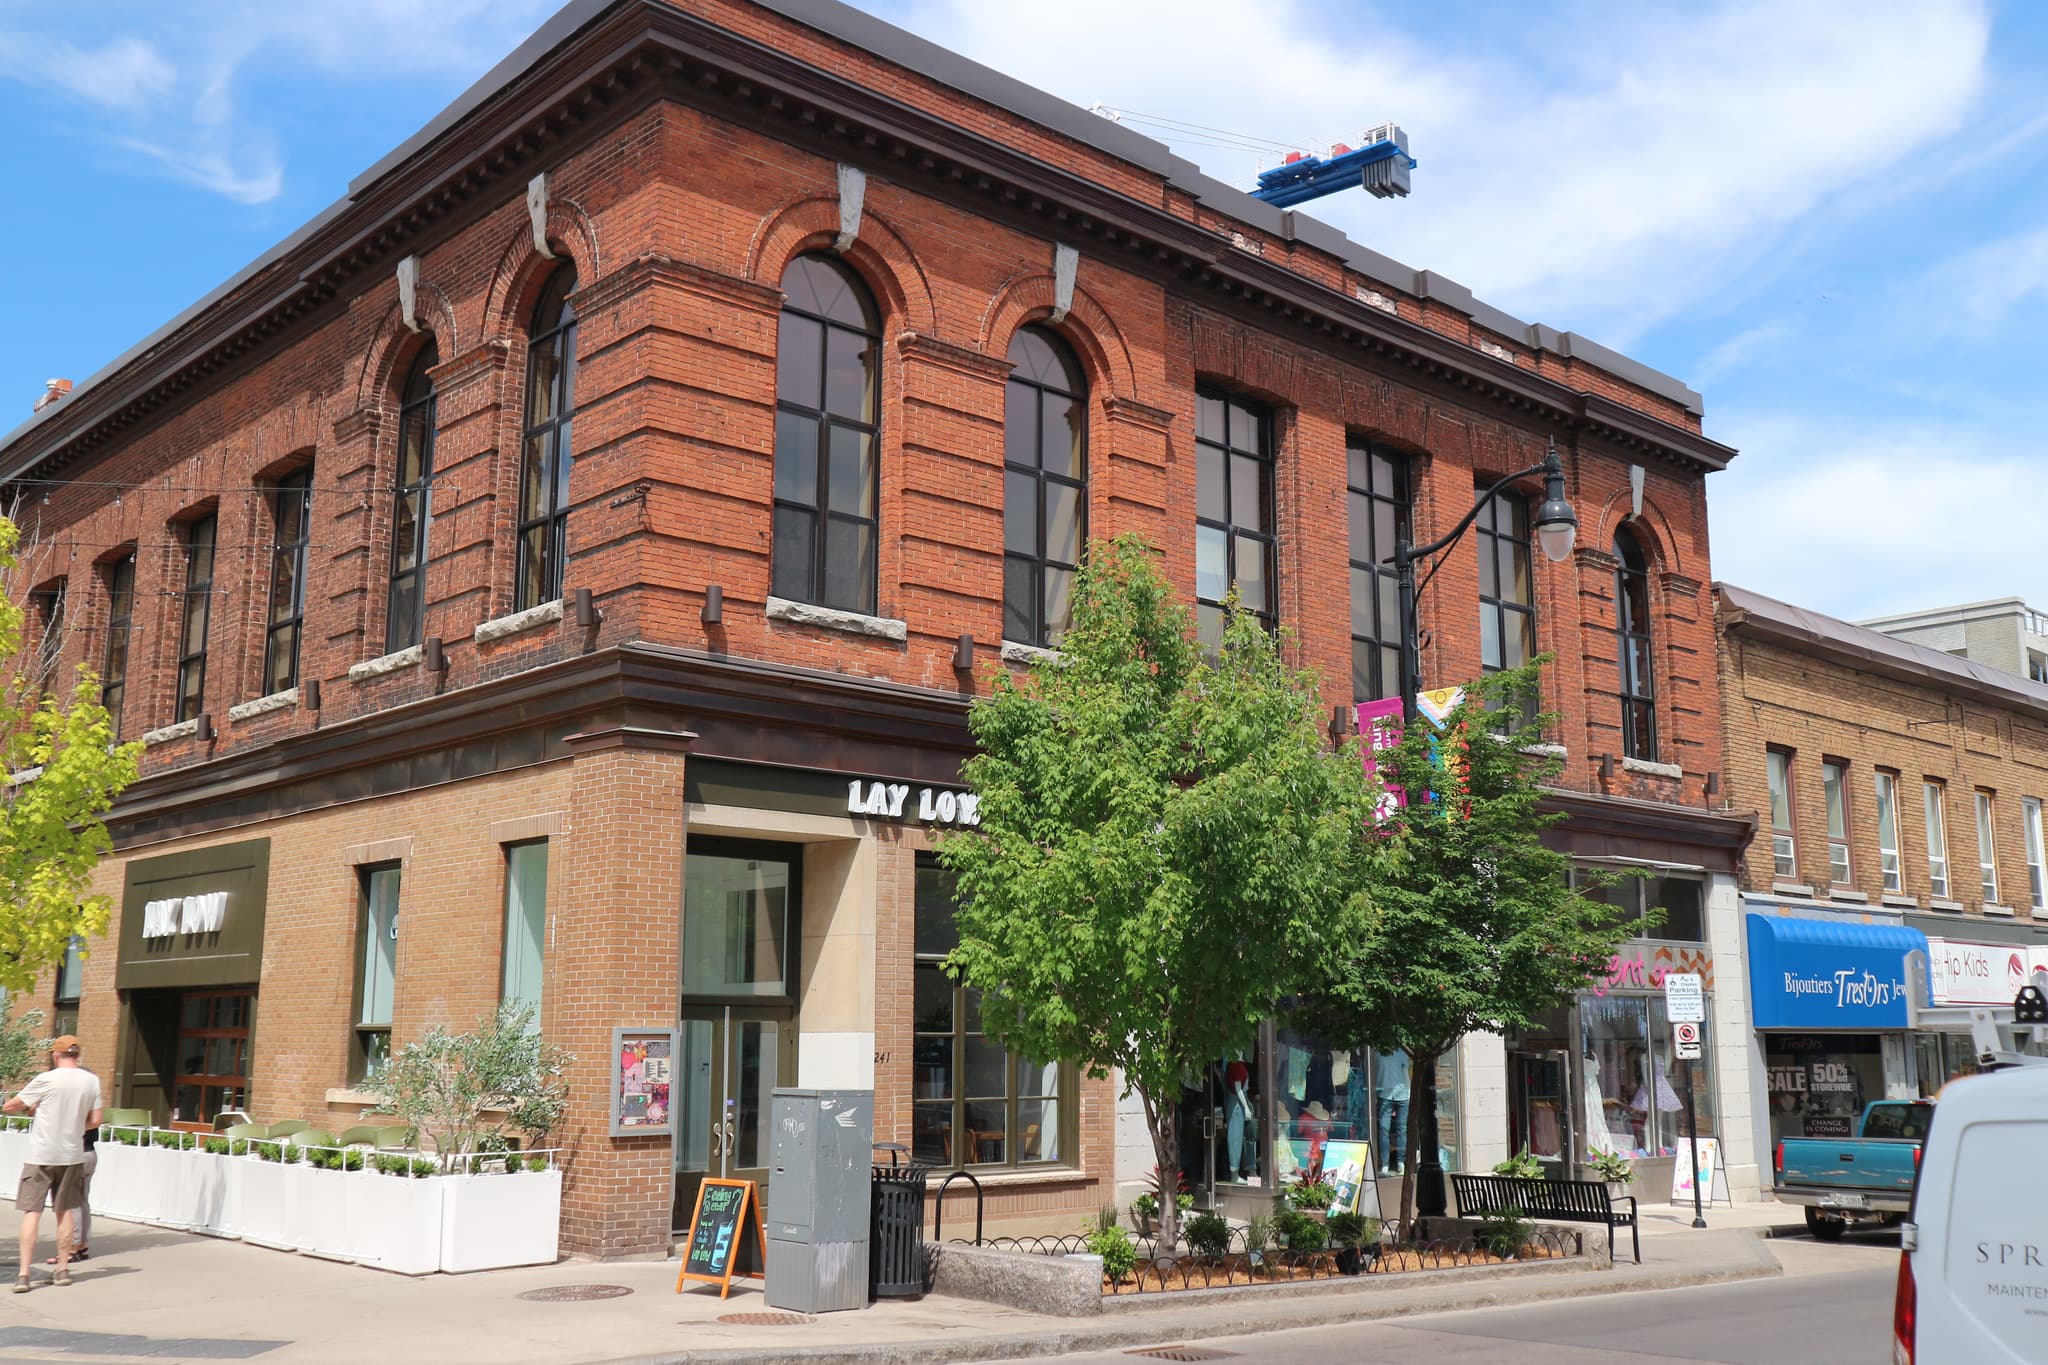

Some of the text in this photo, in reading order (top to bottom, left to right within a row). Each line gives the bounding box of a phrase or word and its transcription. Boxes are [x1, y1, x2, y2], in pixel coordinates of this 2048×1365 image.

[848, 779, 910, 817] LAY
[1963, 950, 1990, 978] Kids
[1669, 986, 1699, 994] Parking
[1784, 971, 1833, 998] Bijoutiers
[1767, 1072, 1807, 1091] SALE
[1976, 1241, 2043, 1267] SPR
